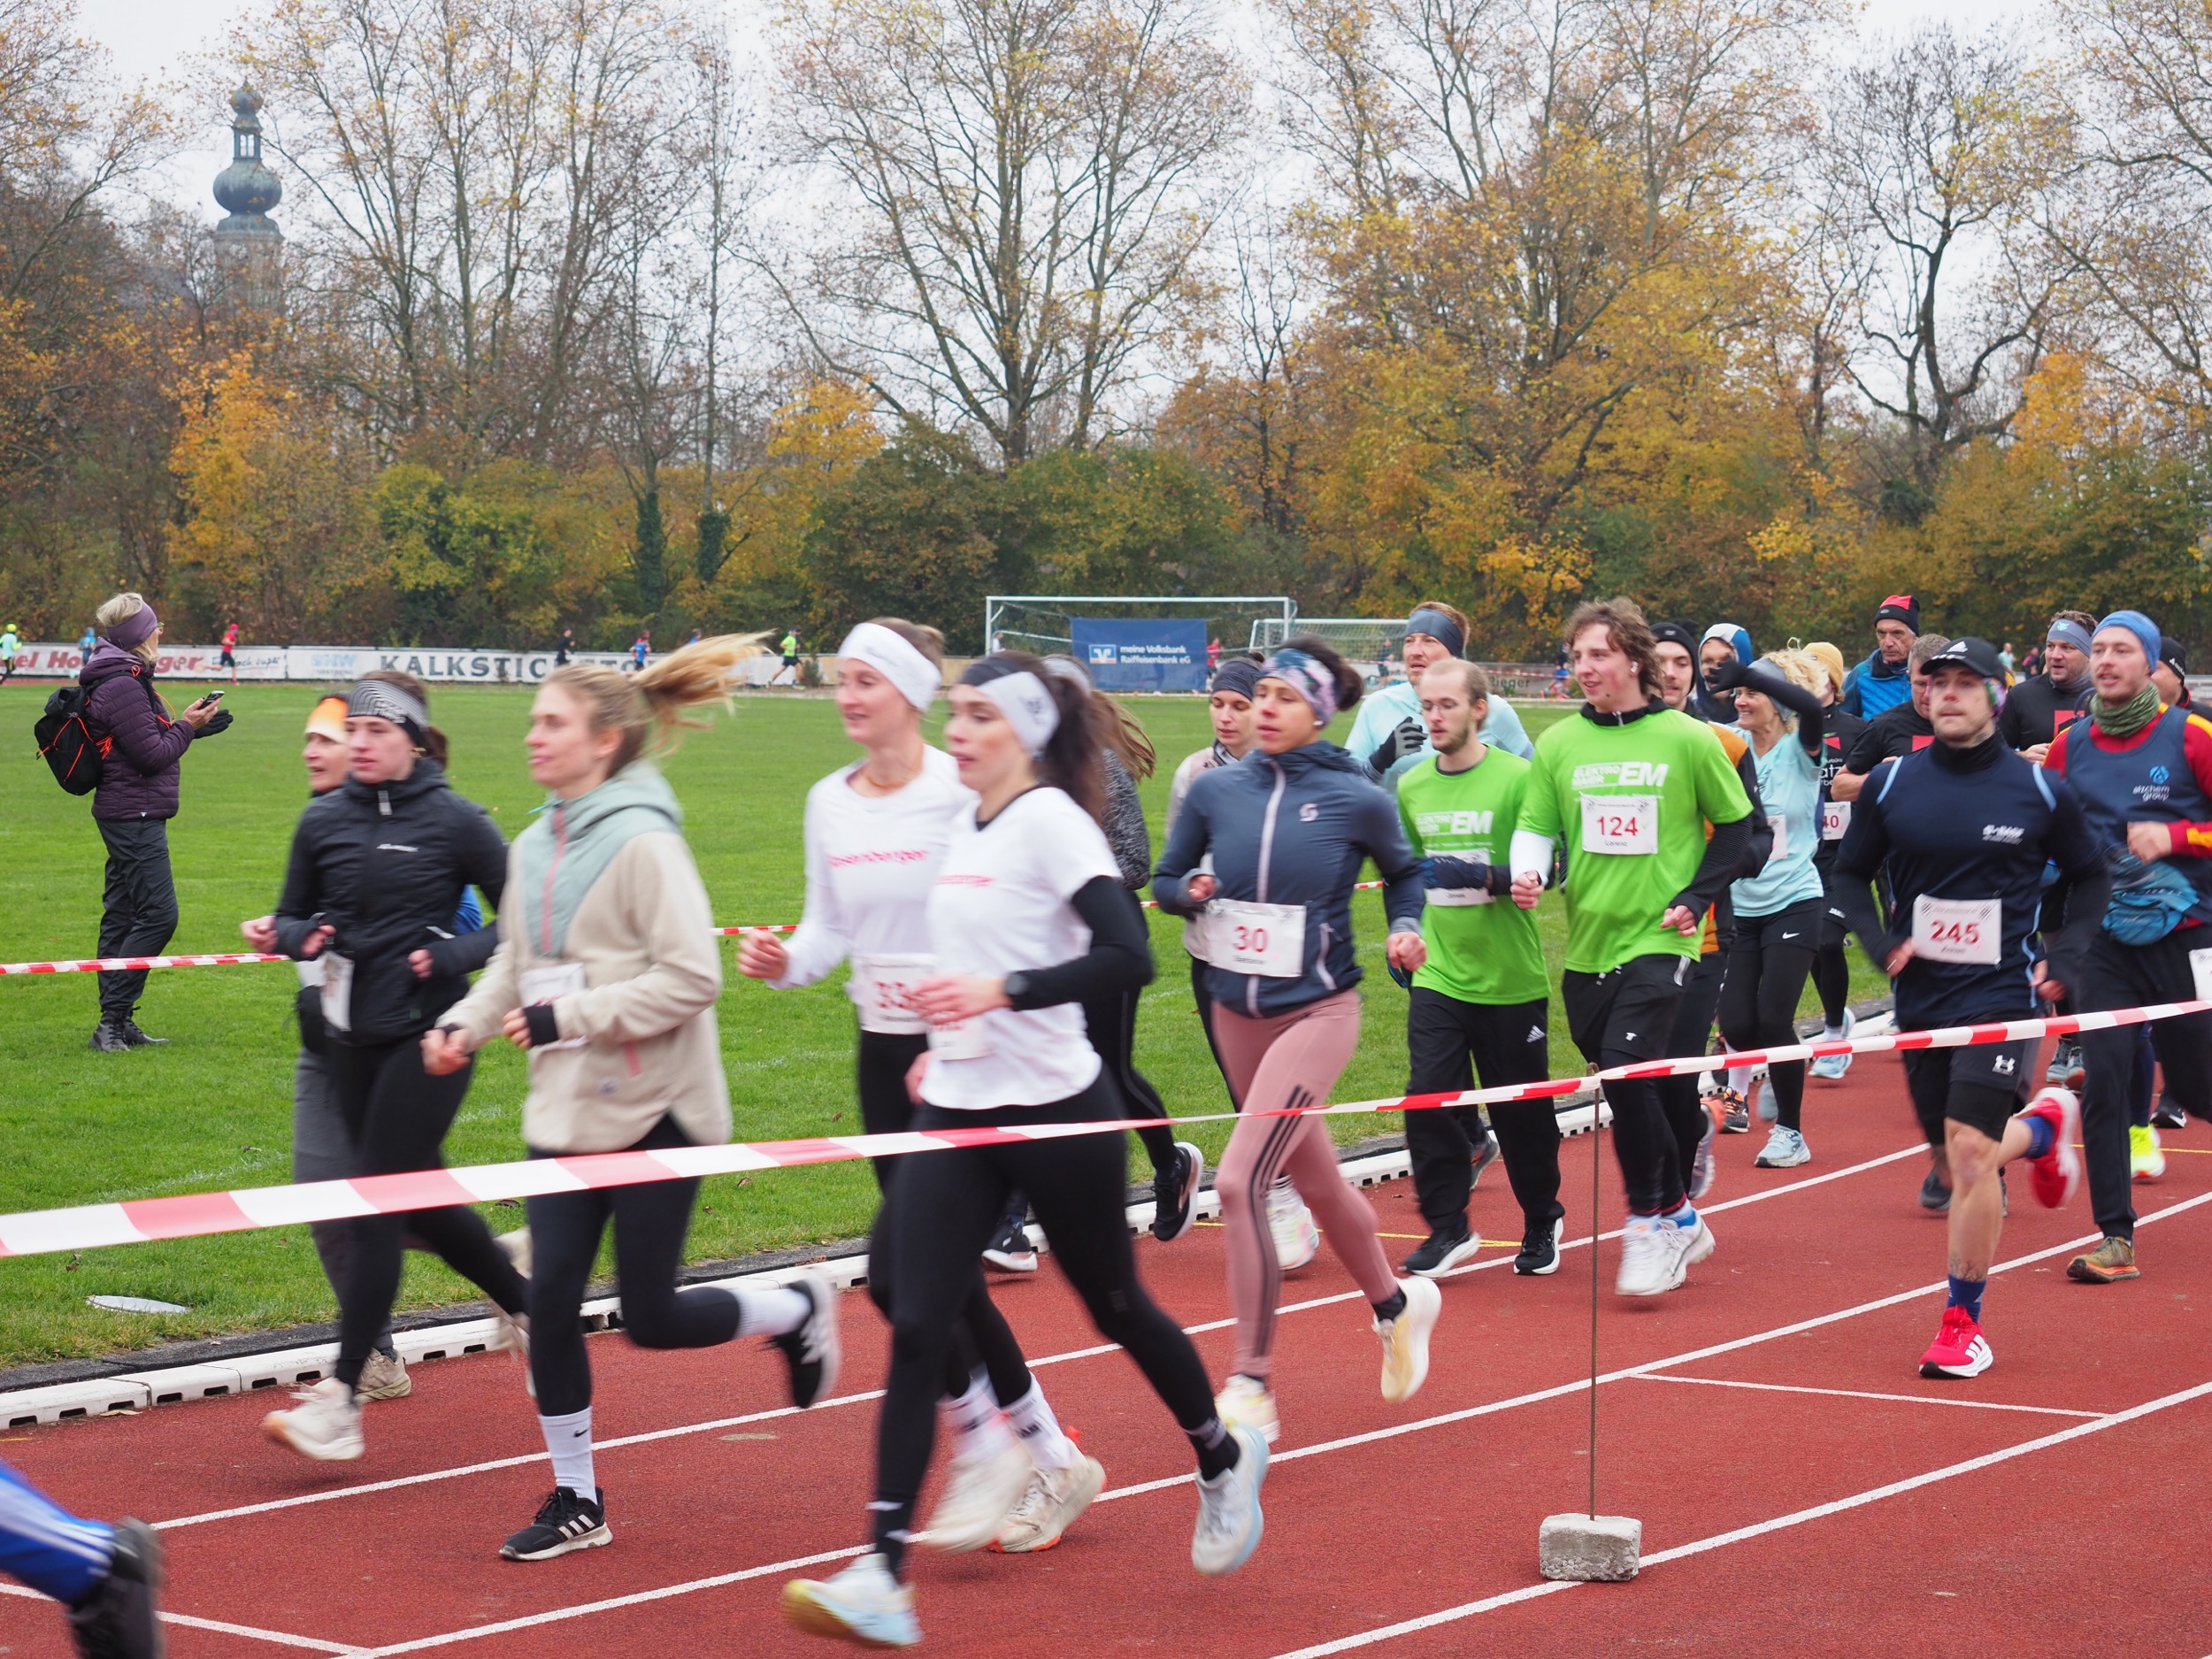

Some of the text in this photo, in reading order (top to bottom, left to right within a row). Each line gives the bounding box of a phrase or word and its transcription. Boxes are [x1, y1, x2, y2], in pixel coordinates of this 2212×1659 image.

[1120, 656, 1191, 664] Raiffeisenbank eG
[1146, 645, 1186, 654] Volksbank
[1618, 762, 1669, 787] EM
[1452, 810, 1494, 834] EM
[1596, 816, 1639, 836] 124
[1233, 926, 1269, 953] 30
[1930, 920, 1980, 944] 245
